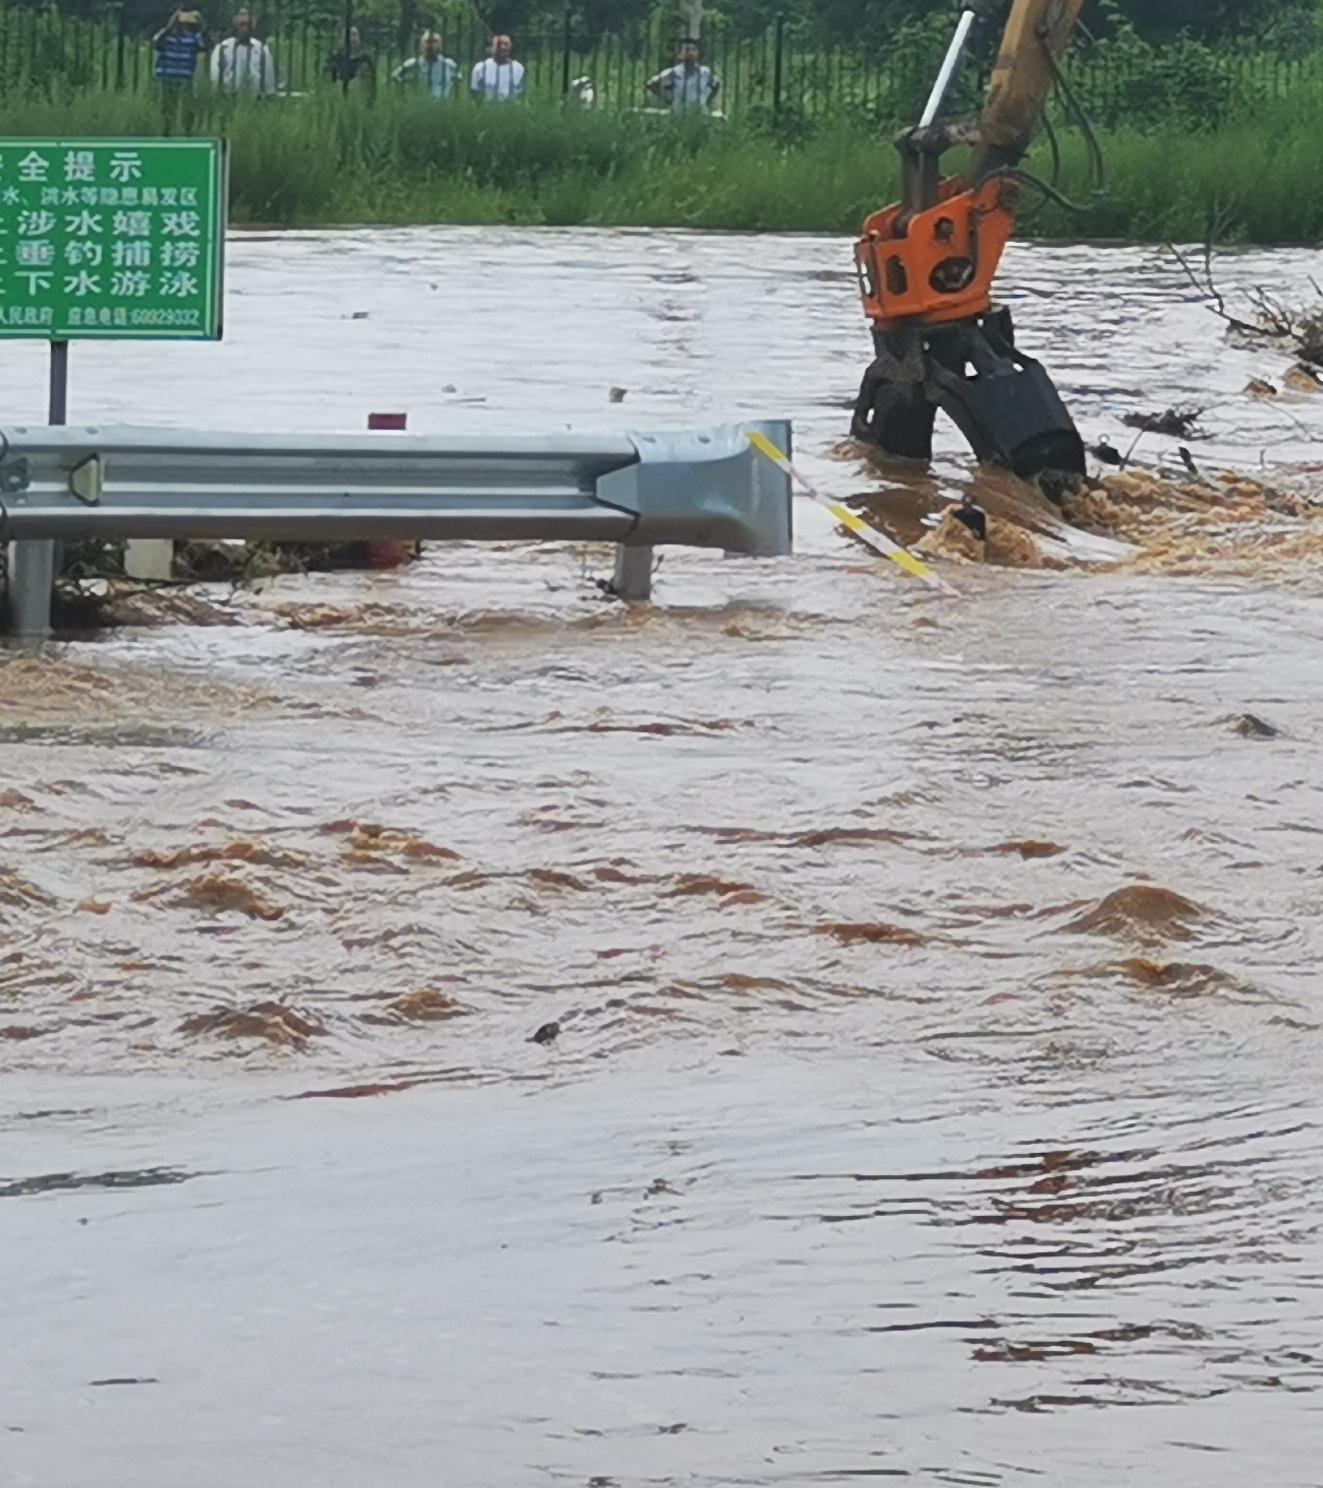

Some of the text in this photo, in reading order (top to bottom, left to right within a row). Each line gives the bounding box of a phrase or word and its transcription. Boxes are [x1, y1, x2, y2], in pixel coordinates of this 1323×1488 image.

[0, 150, 142, 182] 全提示
[0, 210, 200, 237] 涉水嬉戏
[0, 240, 200, 267] 垂钓捕捞
[0, 270, 199, 297] 下水游泳
